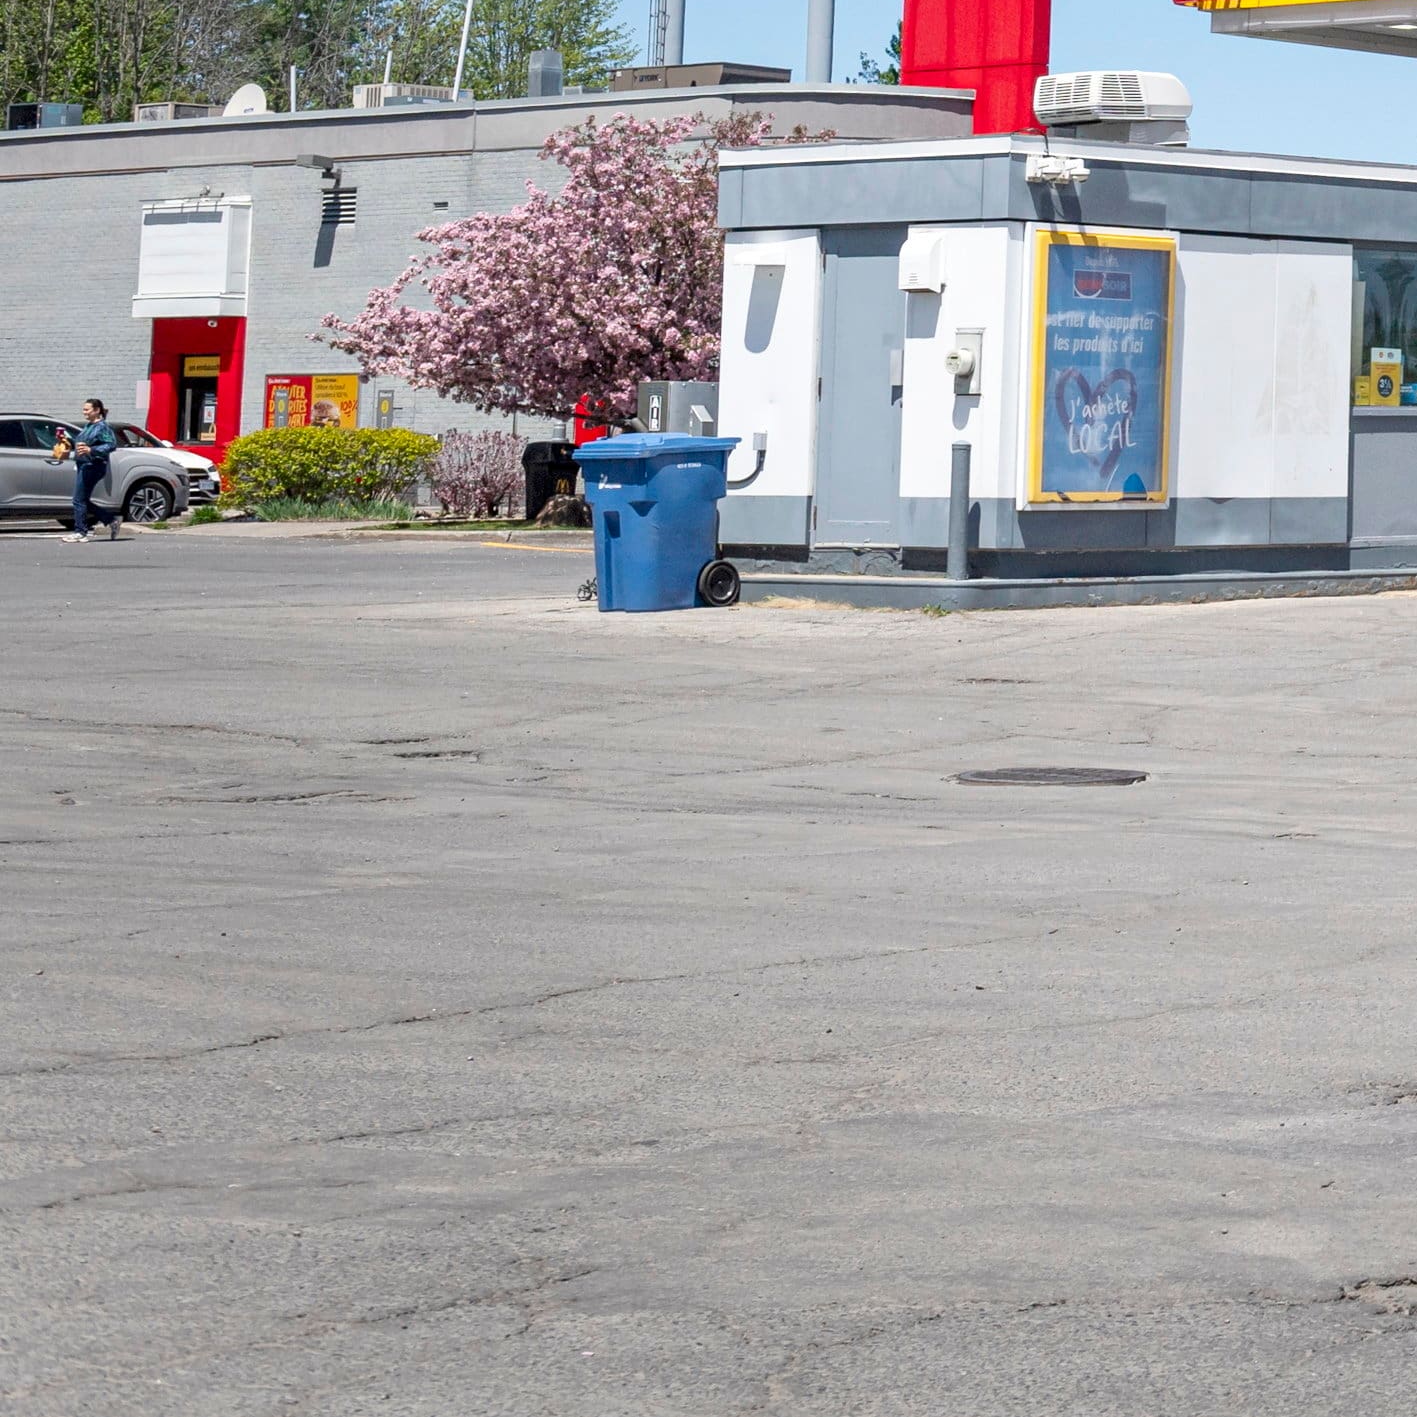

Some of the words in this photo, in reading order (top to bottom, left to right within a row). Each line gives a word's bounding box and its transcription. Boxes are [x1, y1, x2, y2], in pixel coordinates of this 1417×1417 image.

[1103, 314, 1155, 333] supporter
[1054, 334, 1070, 351] les
[651, 396, 660, 429] AIR
[1069, 392, 1129, 423] J'achète
[1068, 418, 1137, 454] LOCAL
